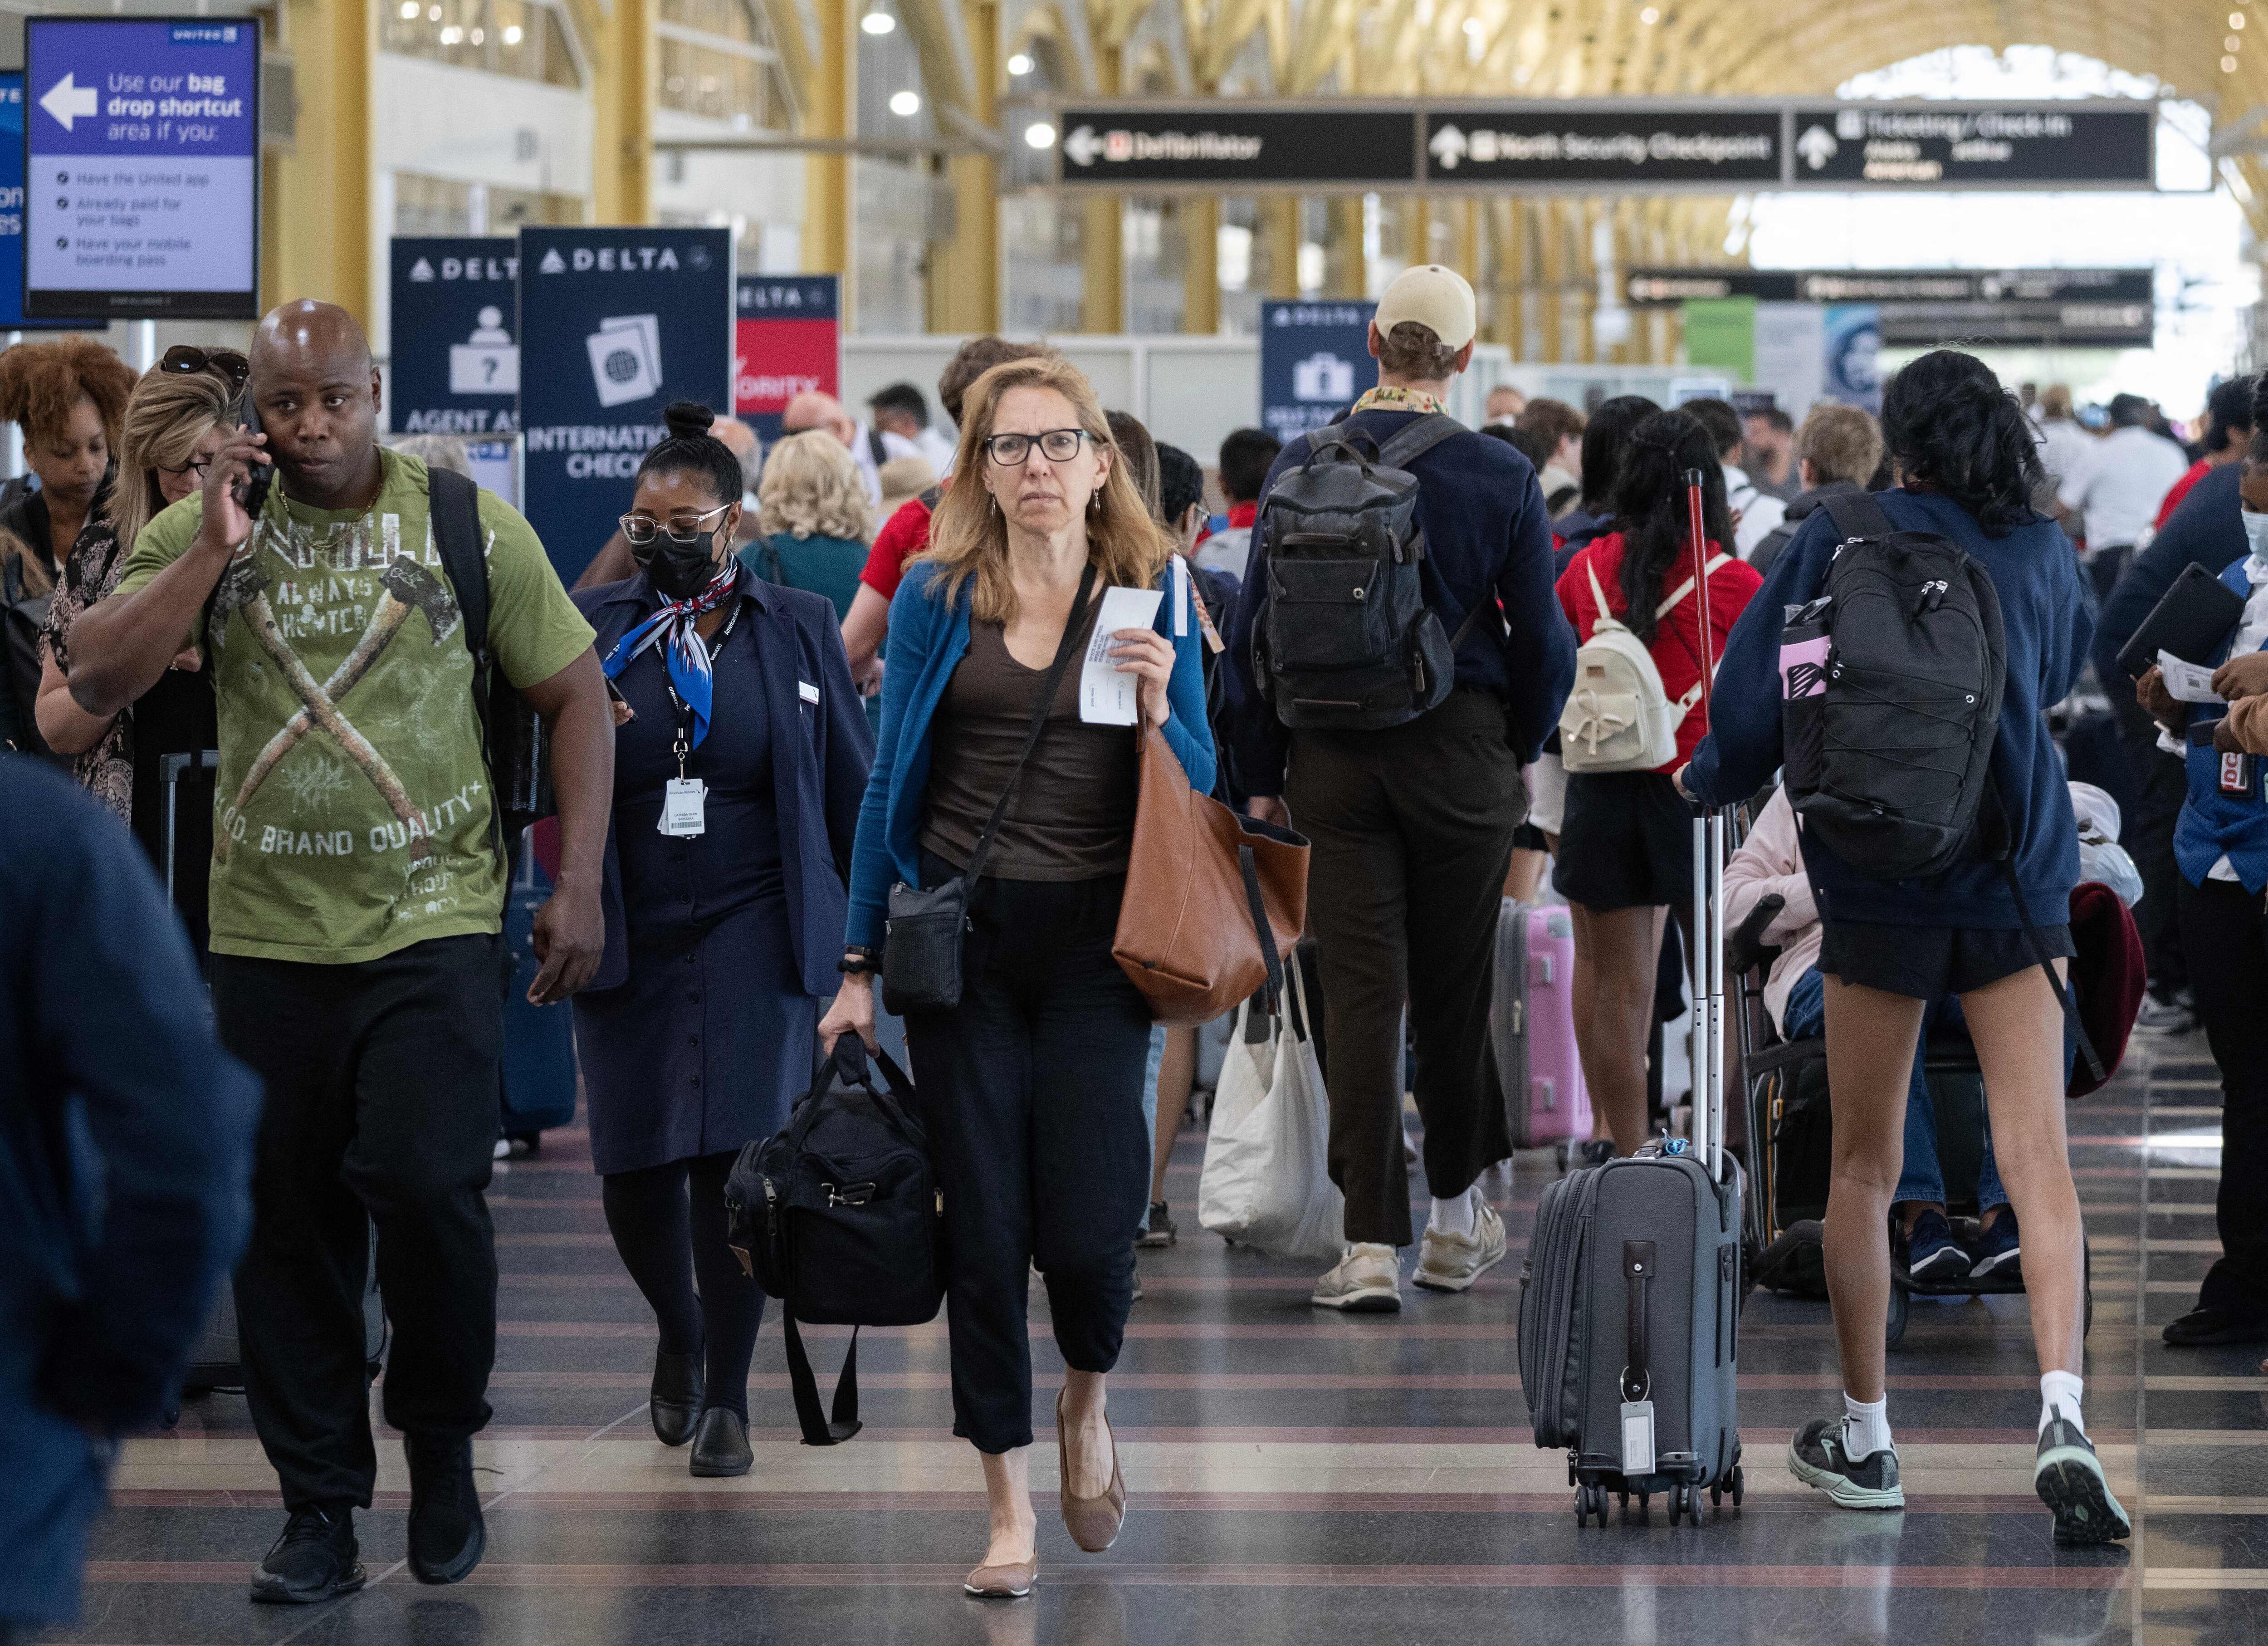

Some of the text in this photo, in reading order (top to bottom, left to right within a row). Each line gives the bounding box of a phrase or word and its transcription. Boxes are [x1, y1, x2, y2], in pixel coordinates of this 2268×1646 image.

[108, 73, 225, 95] Use our bag
[108, 97, 242, 119] drop shortcut
[108, 123, 150, 142] area
[157, 120, 171, 141] if
[572, 247, 679, 272] DELTA
[406, 409, 489, 432] AGENT
[710, 643, 723, 661] oneworld
[259, 825, 354, 856] BRAND
